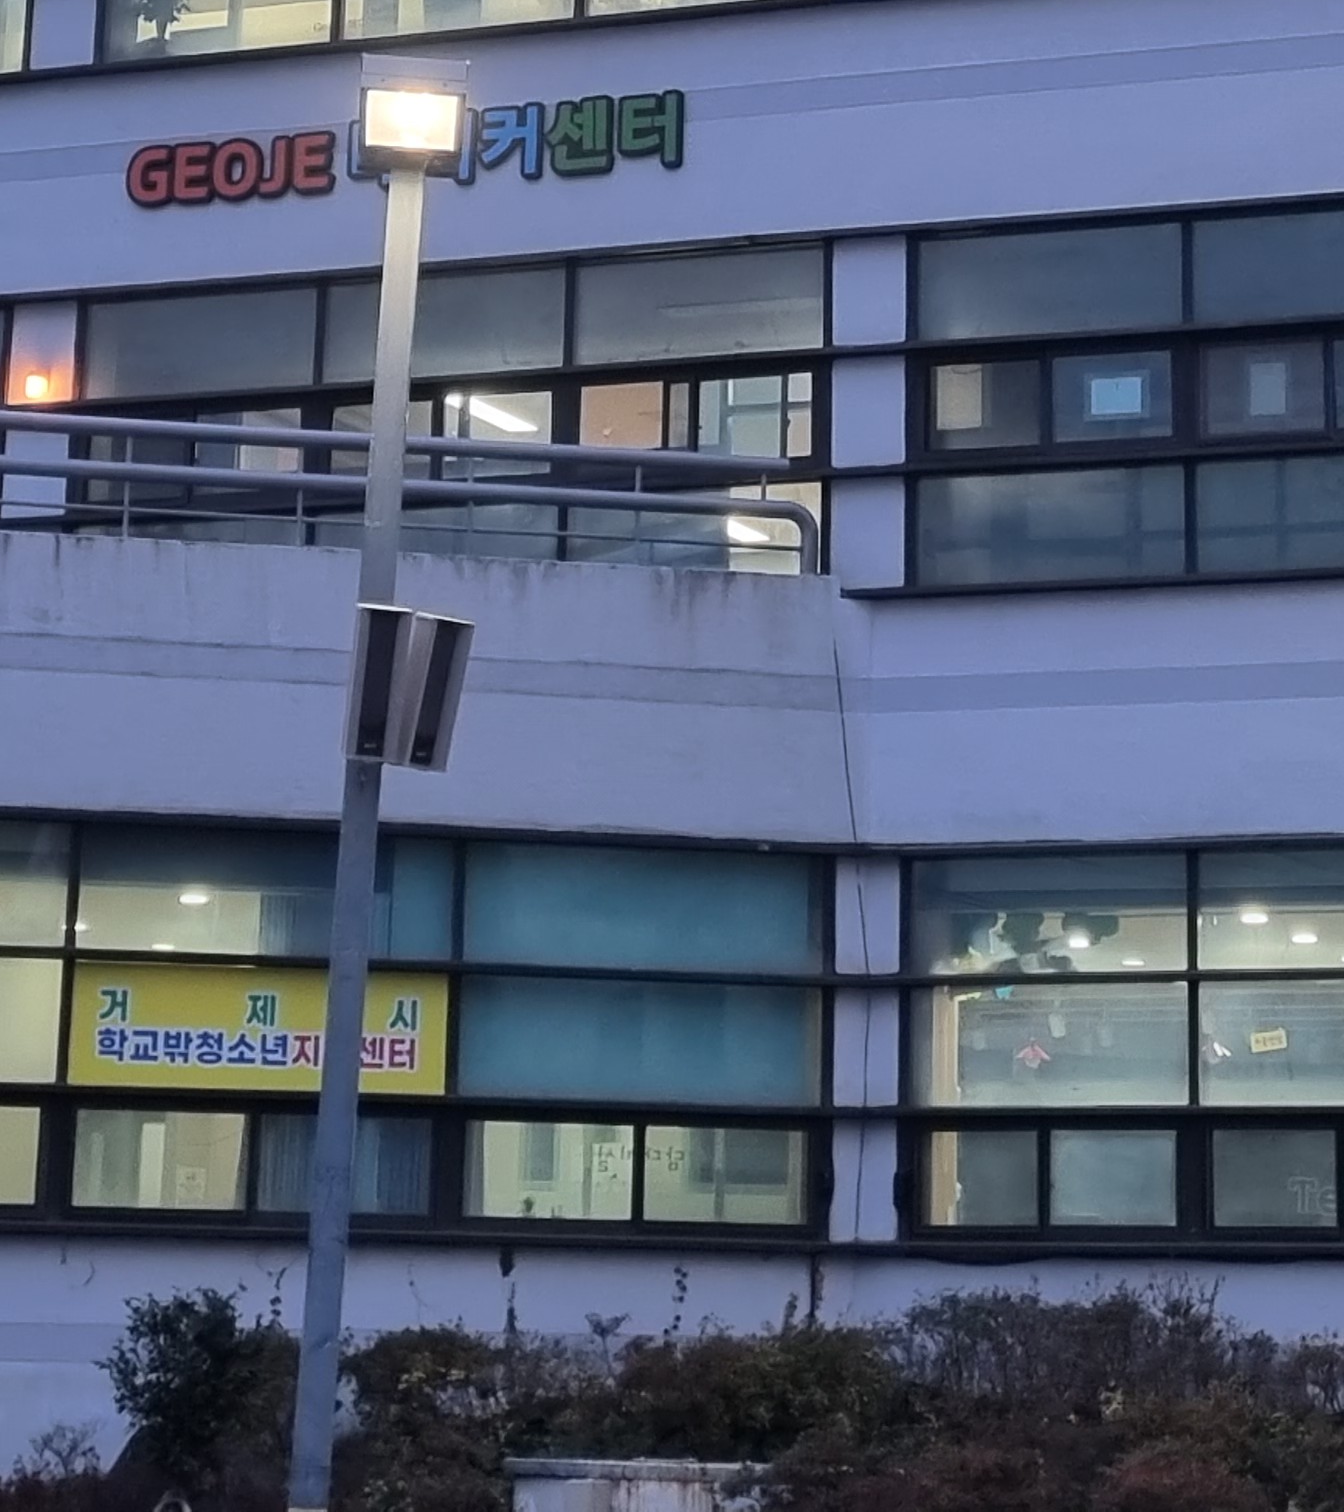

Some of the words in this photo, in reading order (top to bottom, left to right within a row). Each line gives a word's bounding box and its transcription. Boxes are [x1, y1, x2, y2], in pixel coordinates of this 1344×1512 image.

[126, 130, 336, 209] GEOJE
[347, 89, 685, 190] 커센터
[97, 988, 131, 1023] 거
[245, 993, 278, 1028] 제
[388, 997, 420, 1033] 시
[96, 1027, 419, 1072] 학교밖청소년지센터
